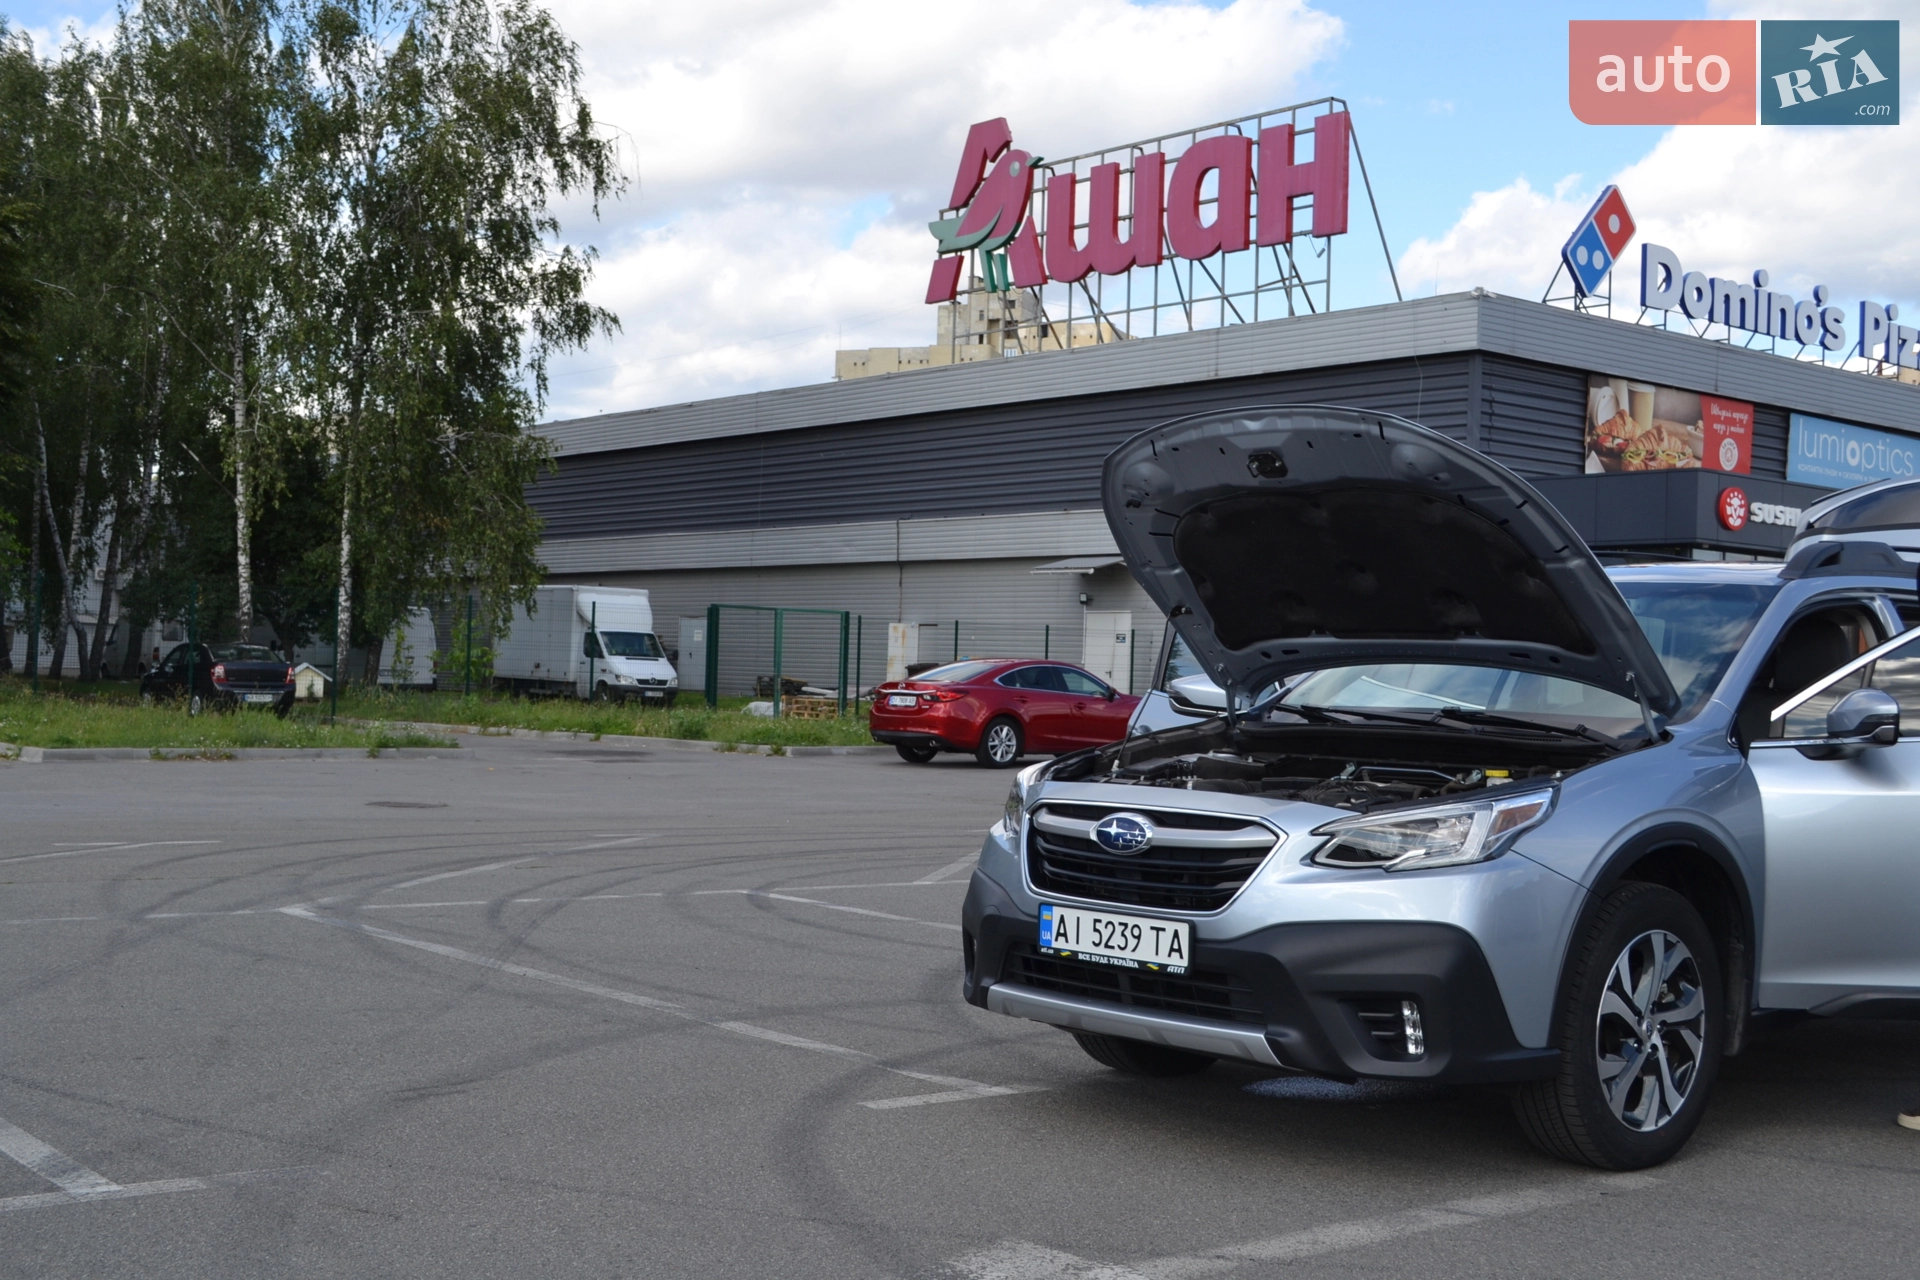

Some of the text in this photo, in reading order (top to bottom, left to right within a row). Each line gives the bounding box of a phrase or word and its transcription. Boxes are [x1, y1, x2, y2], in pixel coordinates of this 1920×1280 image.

[925, 111, 1350, 304] Ашан
[1640, 243, 1920, 370] Domino's Piz
[1798, 418, 1914, 477] lumioptics
[1042, 931, 1051, 940] UA
[1054, 914, 1184, 960] AI 5239 TA
[1078, 953, 1139, 969] ВСЕ БУДЕ УКРАЇНА
